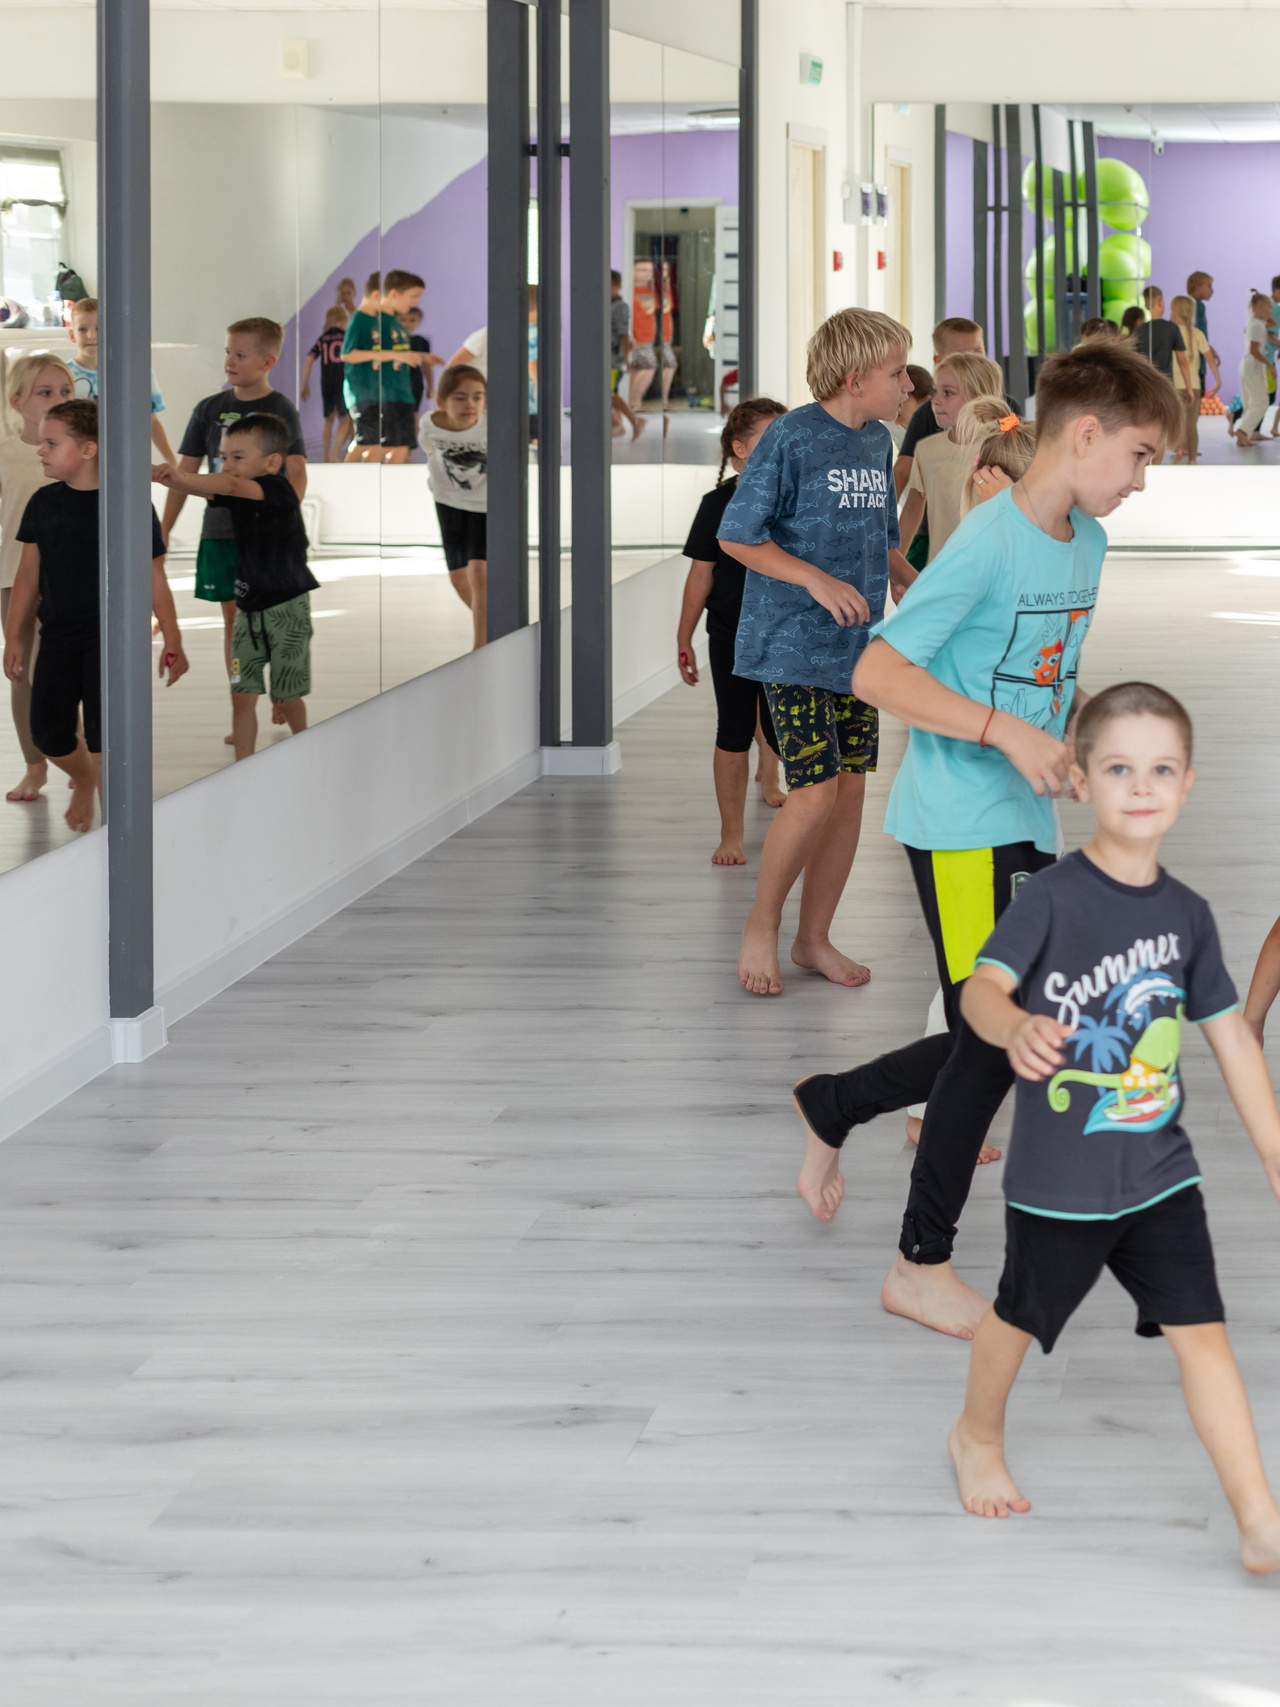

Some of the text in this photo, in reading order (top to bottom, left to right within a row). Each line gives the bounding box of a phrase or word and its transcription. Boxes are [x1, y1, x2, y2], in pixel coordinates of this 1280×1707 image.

[838, 493, 887, 508] ATTACK
[1017, 592, 1065, 607] ALWAYS
[803, 752, 822, 766] SPORT
[1043, 932, 1181, 1031] Summer
